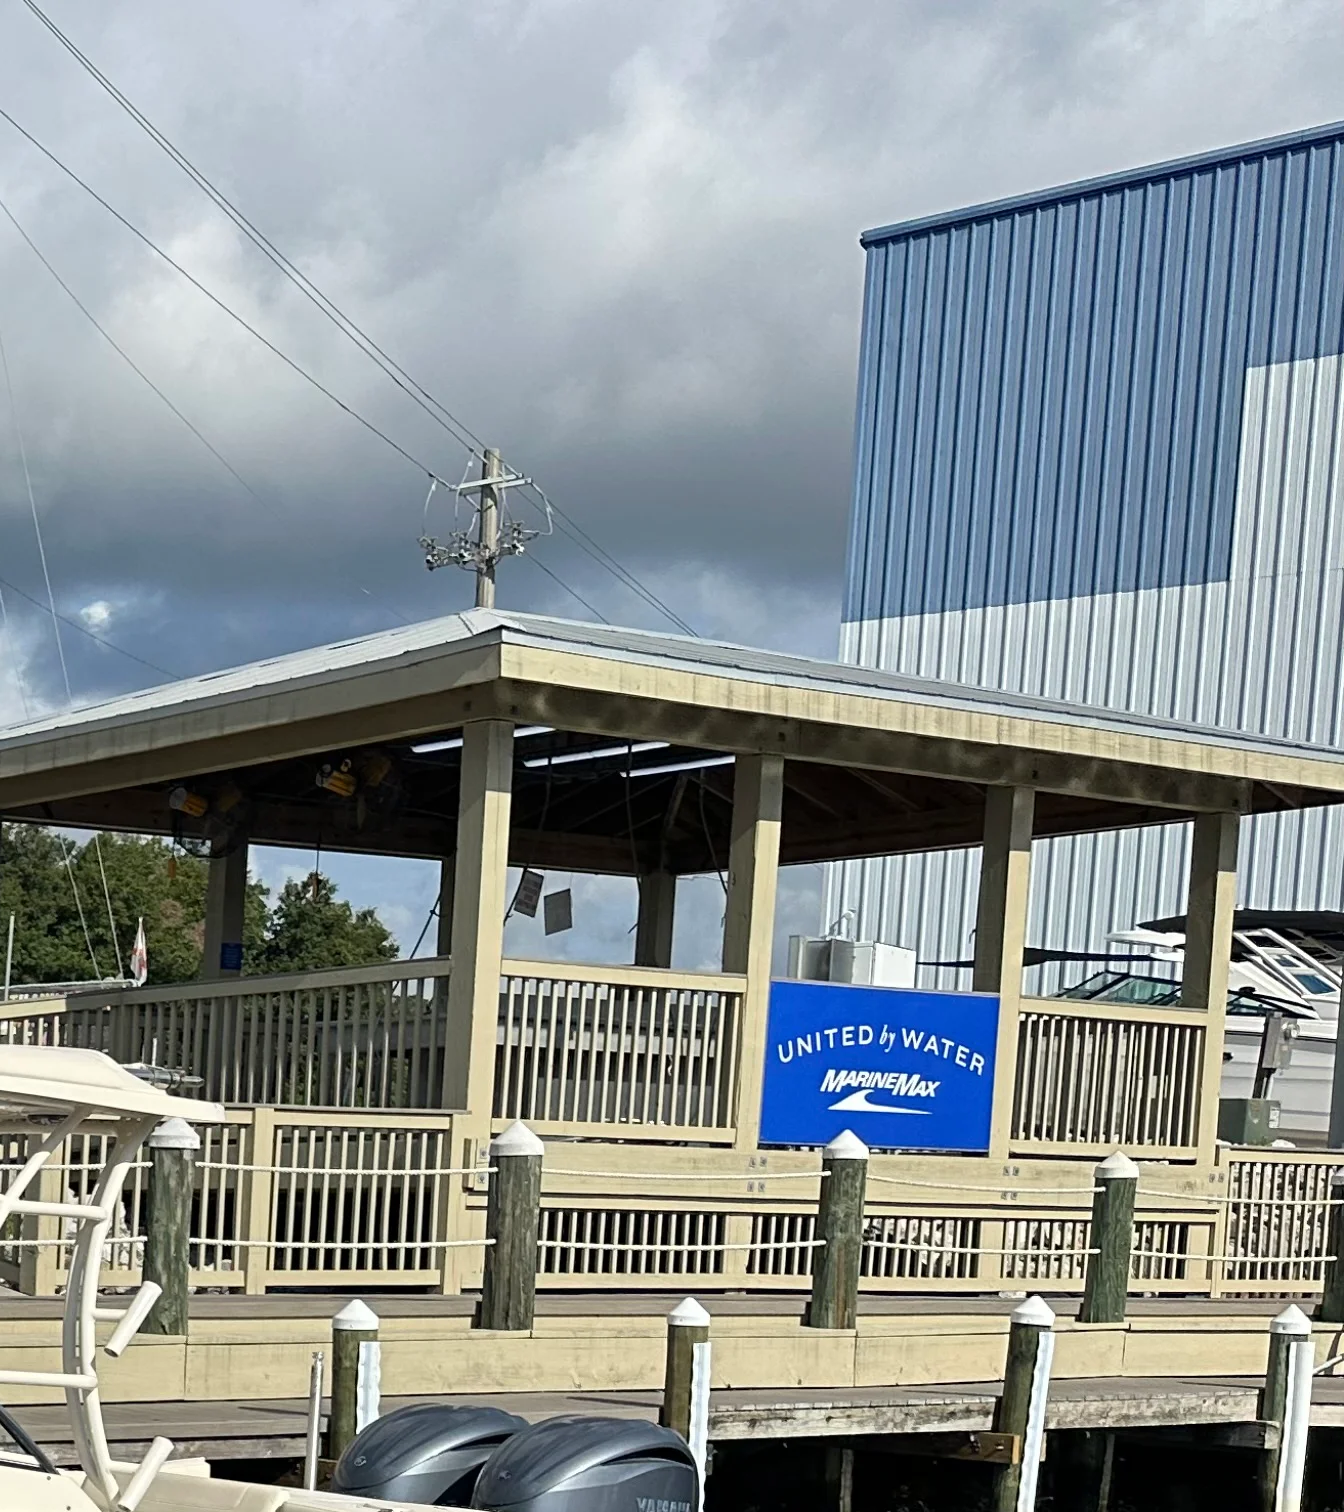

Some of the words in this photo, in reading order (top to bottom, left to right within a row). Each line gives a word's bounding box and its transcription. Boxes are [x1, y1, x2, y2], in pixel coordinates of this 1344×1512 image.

[778, 1025, 874, 1063] UNITED
[879, 1024, 897, 1052] by
[901, 1027, 985, 1076] WATER
